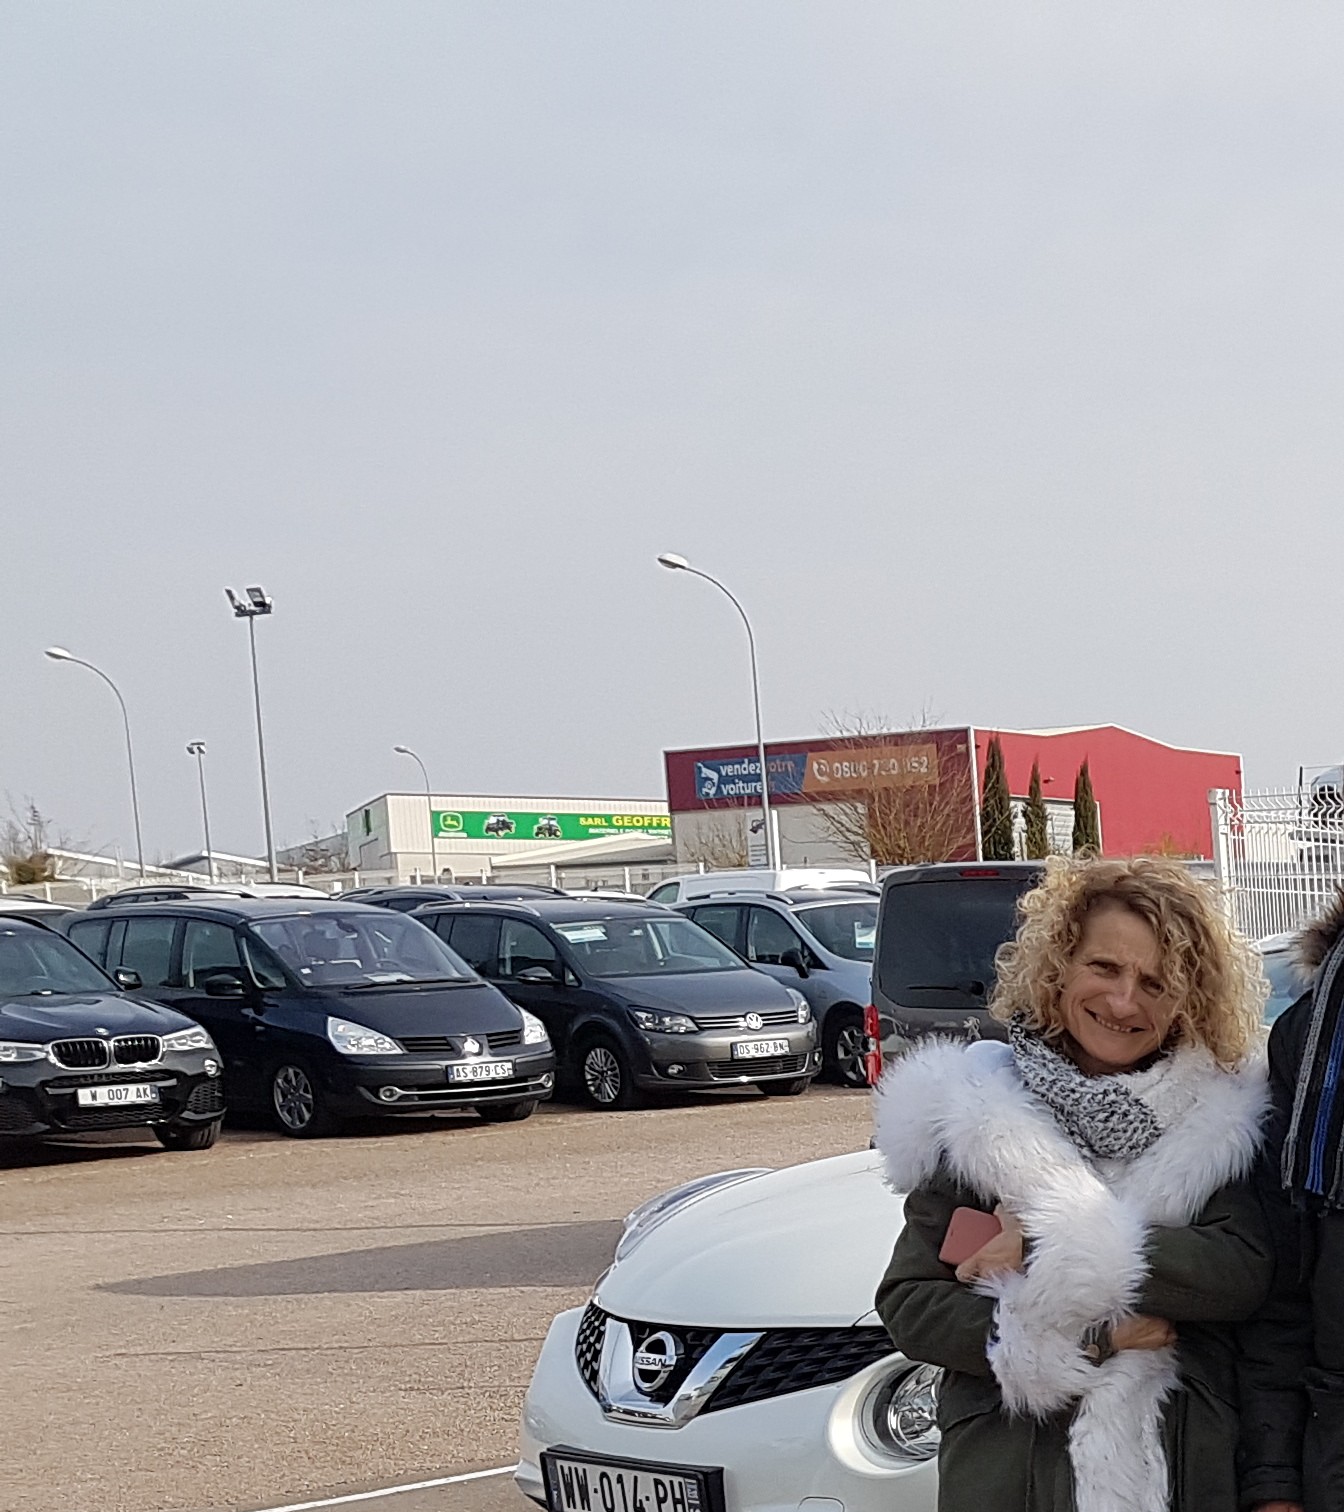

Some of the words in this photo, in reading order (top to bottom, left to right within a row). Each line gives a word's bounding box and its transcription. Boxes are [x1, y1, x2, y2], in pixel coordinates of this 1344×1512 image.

[720, 759, 761, 776] vendez
[579, 817, 608, 826] SARL
[107, 1087, 129, 1101] 007
